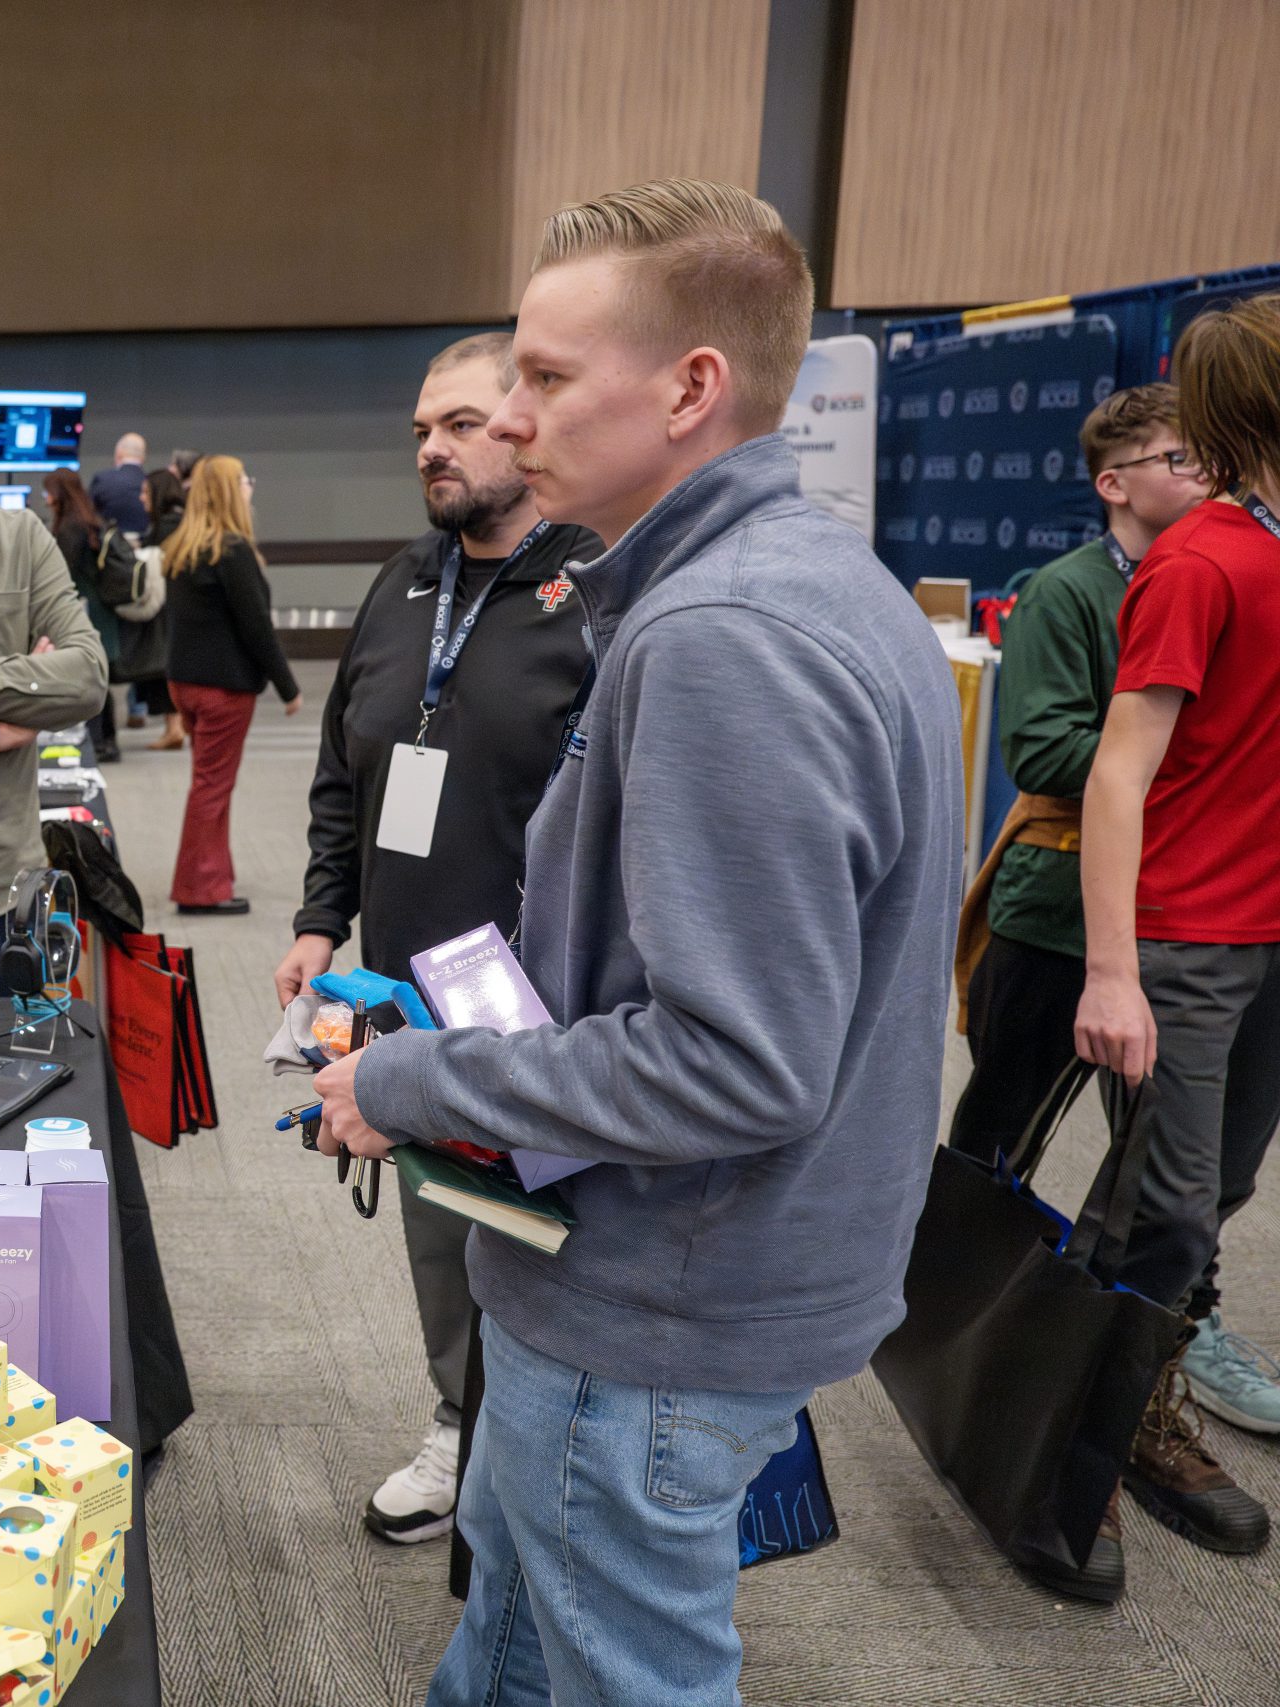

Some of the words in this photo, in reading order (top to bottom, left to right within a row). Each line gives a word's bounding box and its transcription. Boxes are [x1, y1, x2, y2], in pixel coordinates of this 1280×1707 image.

[435, 605, 446, 630] BOCES
[450, 633, 466, 658] BOCES
[428, 965, 453, 982] E-Z
[453, 945, 499, 970] Breezy
